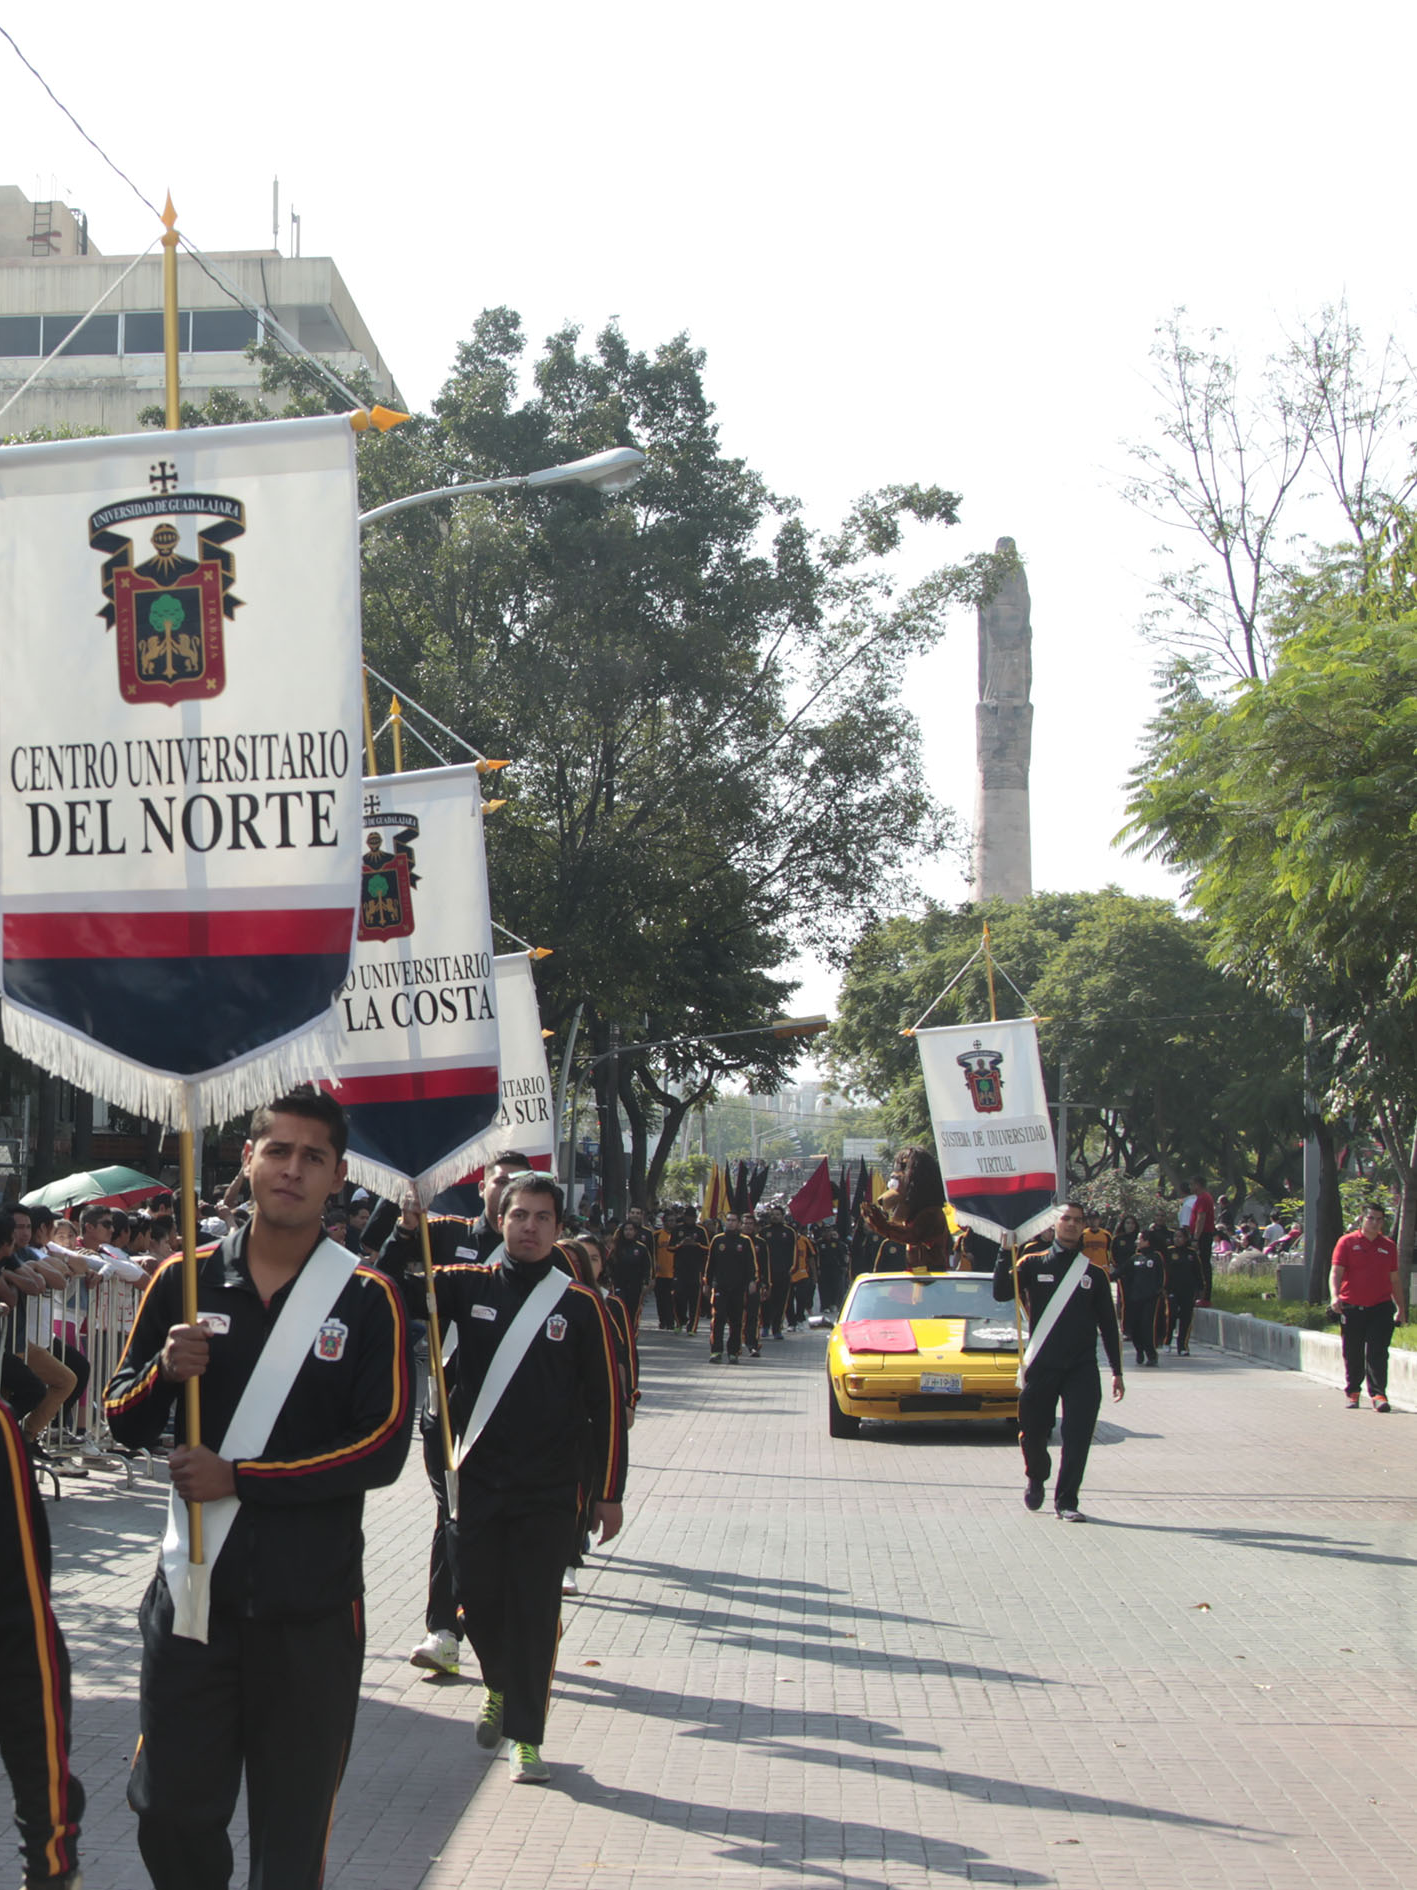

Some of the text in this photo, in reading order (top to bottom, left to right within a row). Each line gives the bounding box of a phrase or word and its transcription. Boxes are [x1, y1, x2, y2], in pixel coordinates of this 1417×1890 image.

[92, 498, 239, 528] UNIVERSIDAD DE GUADALAJARA
[10, 728, 350, 794] CENTRO UNIVERSITARIO
[27, 789, 340, 858] DEL NORTE
[375, 816, 416, 827] GUADALAJARA
[359, 951, 491, 991] UNIVERSITARIO
[342, 983, 495, 1033] LA COSTA
[501, 1075, 545, 1098] ITARIO
[514, 1097, 550, 1125] SUR
[941, 1124, 1048, 1148] SISTEMA DE UNIVERSIDAD
[976, 1155, 1017, 1174] VIRTUAL
